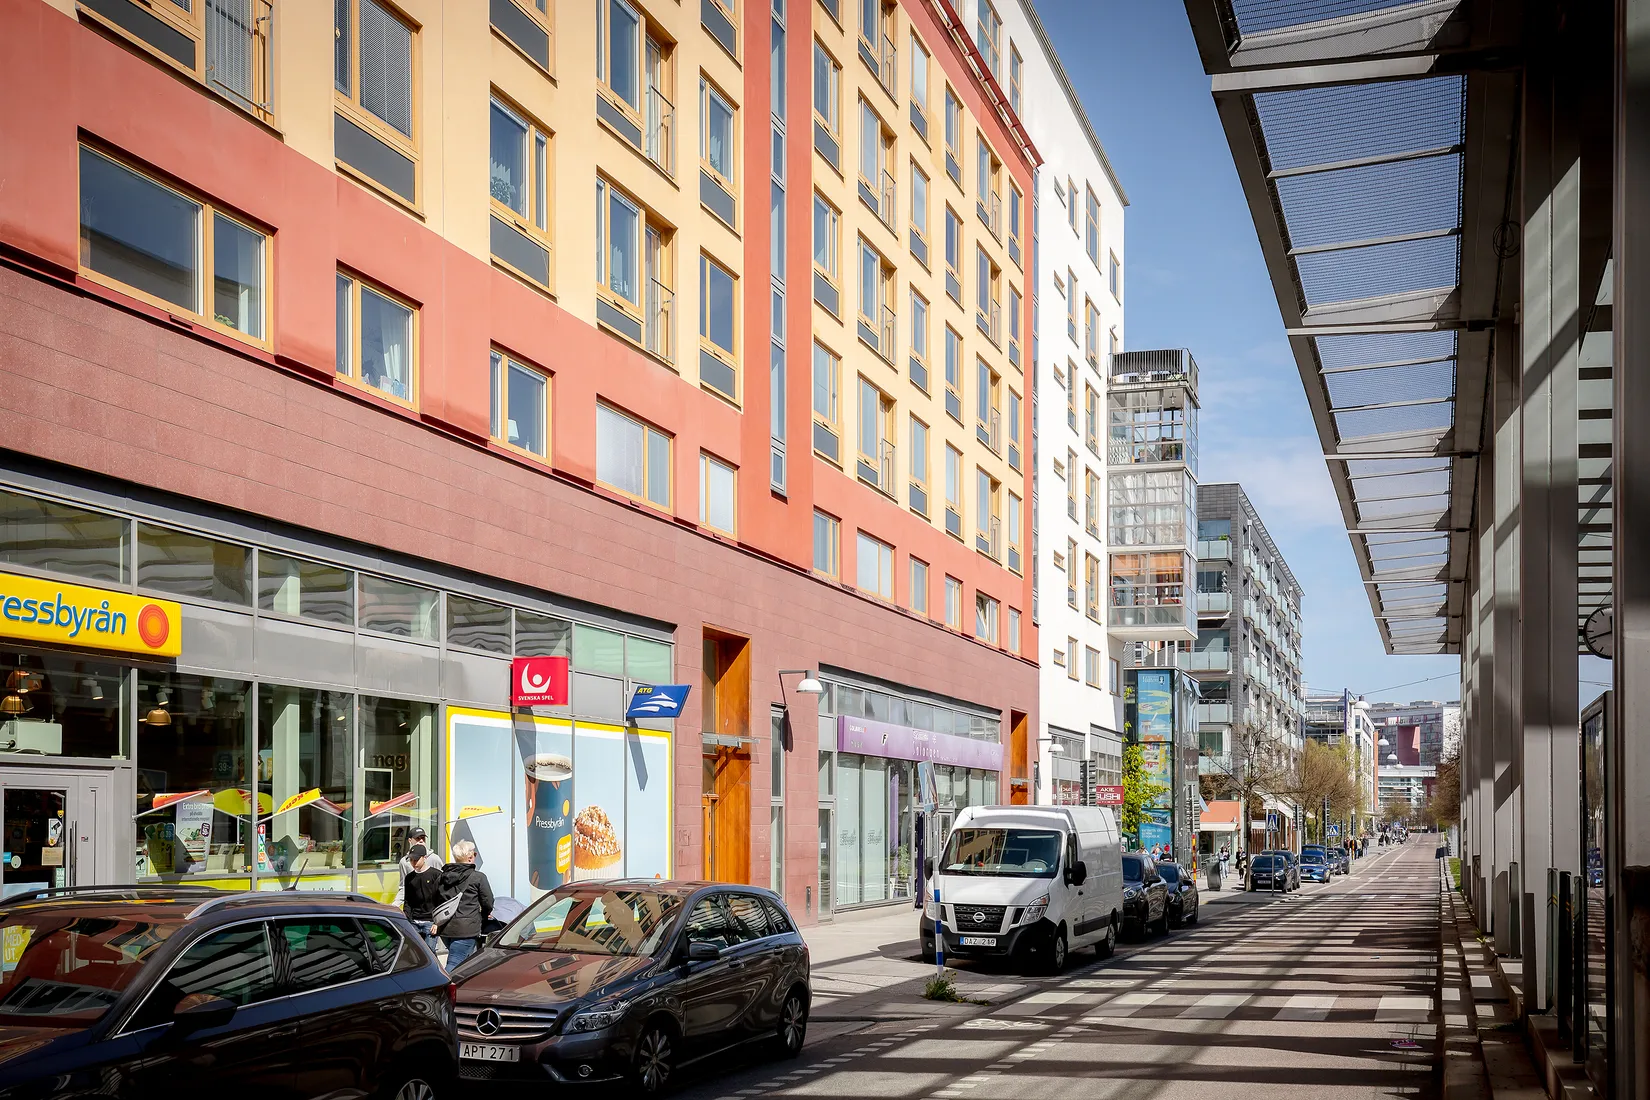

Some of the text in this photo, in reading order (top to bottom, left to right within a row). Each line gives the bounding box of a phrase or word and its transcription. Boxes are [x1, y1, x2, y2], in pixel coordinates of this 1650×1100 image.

[535, 815, 565, 831] Pressbyrån
[464, 1044, 514, 1060] APT 271
